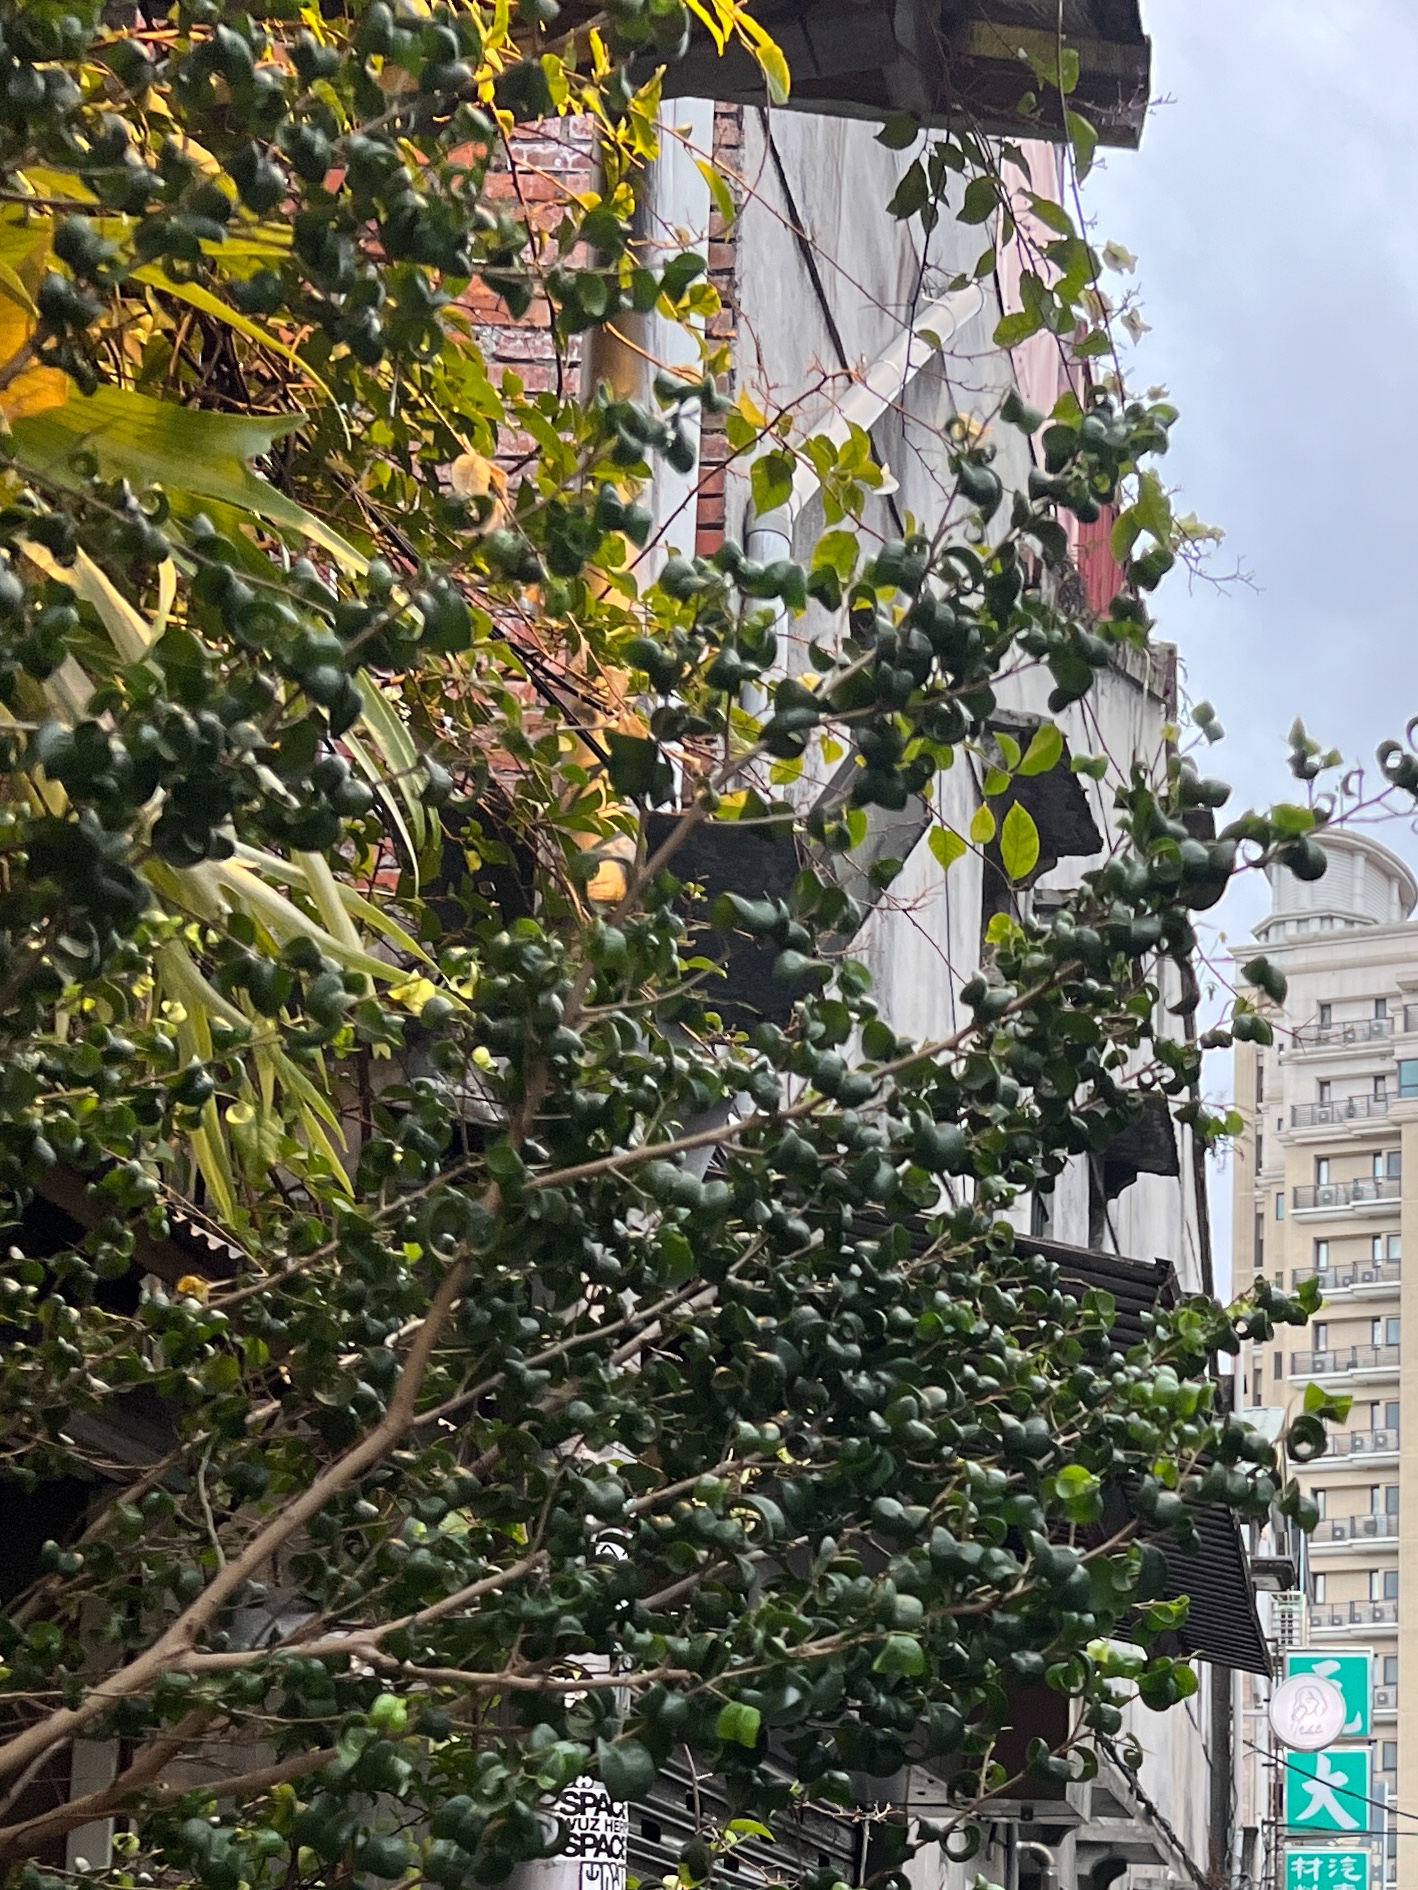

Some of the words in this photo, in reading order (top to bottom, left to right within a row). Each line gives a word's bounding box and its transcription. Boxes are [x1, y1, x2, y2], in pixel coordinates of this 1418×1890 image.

[1295, 1751, 1361, 1829] 大
[560, 1791, 627, 1819] SPAC
[561, 1832, 627, 1860] SPAC
